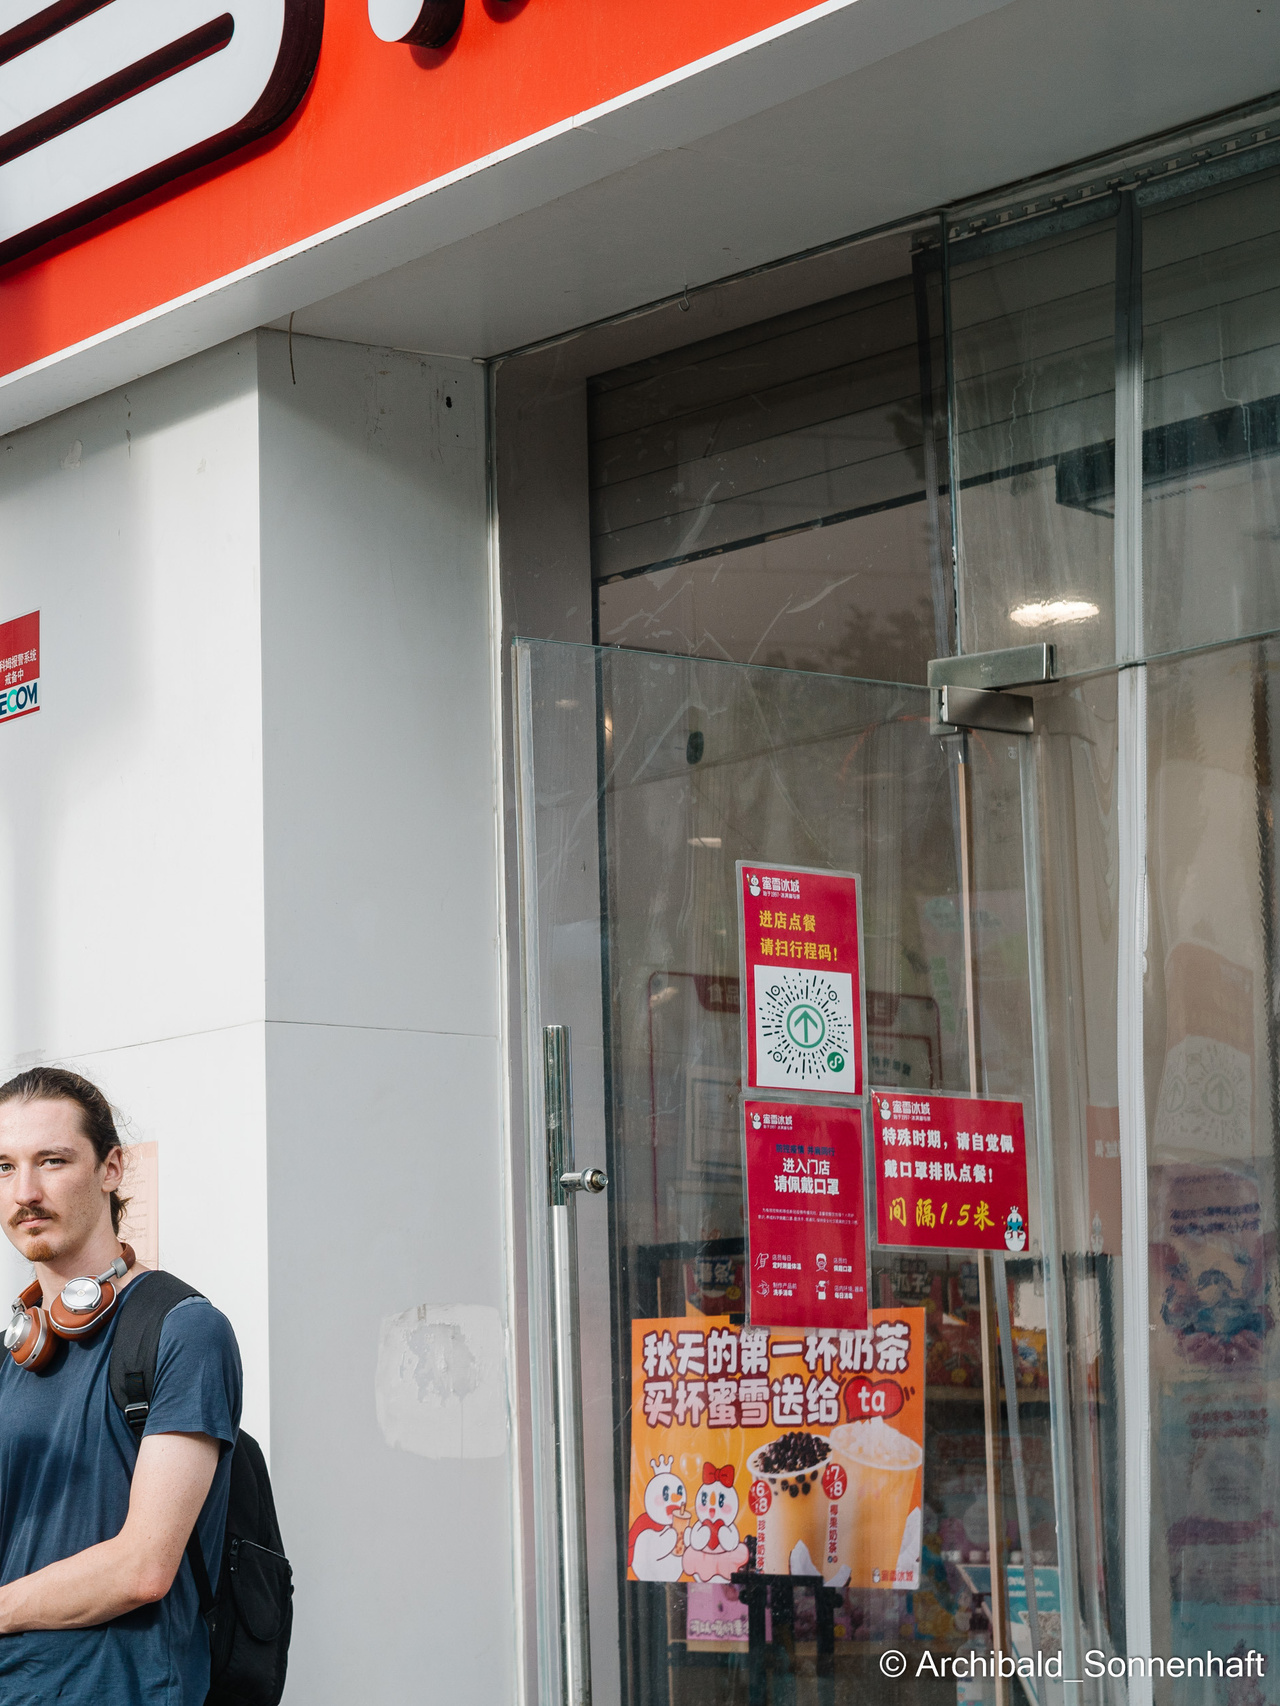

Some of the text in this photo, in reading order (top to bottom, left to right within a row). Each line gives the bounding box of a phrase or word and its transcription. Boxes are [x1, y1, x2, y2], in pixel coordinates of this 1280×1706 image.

[761, 876, 800, 893] 蜜雪冰城
[759, 910, 816, 932] 进店点餐
[760, 937, 837, 961] 请扫行程码！
[892, 1100, 930, 1115] 蜜雪冰城
[882, 1127, 1014, 1153] 特殊时期，请自觉佩
[782, 1157, 830, 1175] 进入门店
[884, 1159, 993, 1183] 戴口罩排队点餐！
[774, 1175, 839, 1195] 请佩戴口罩
[643, 1322, 910, 1377] 秋天的第一杯奶茶
[644, 1375, 886, 1427] 买杯蜜雪送给 ta
